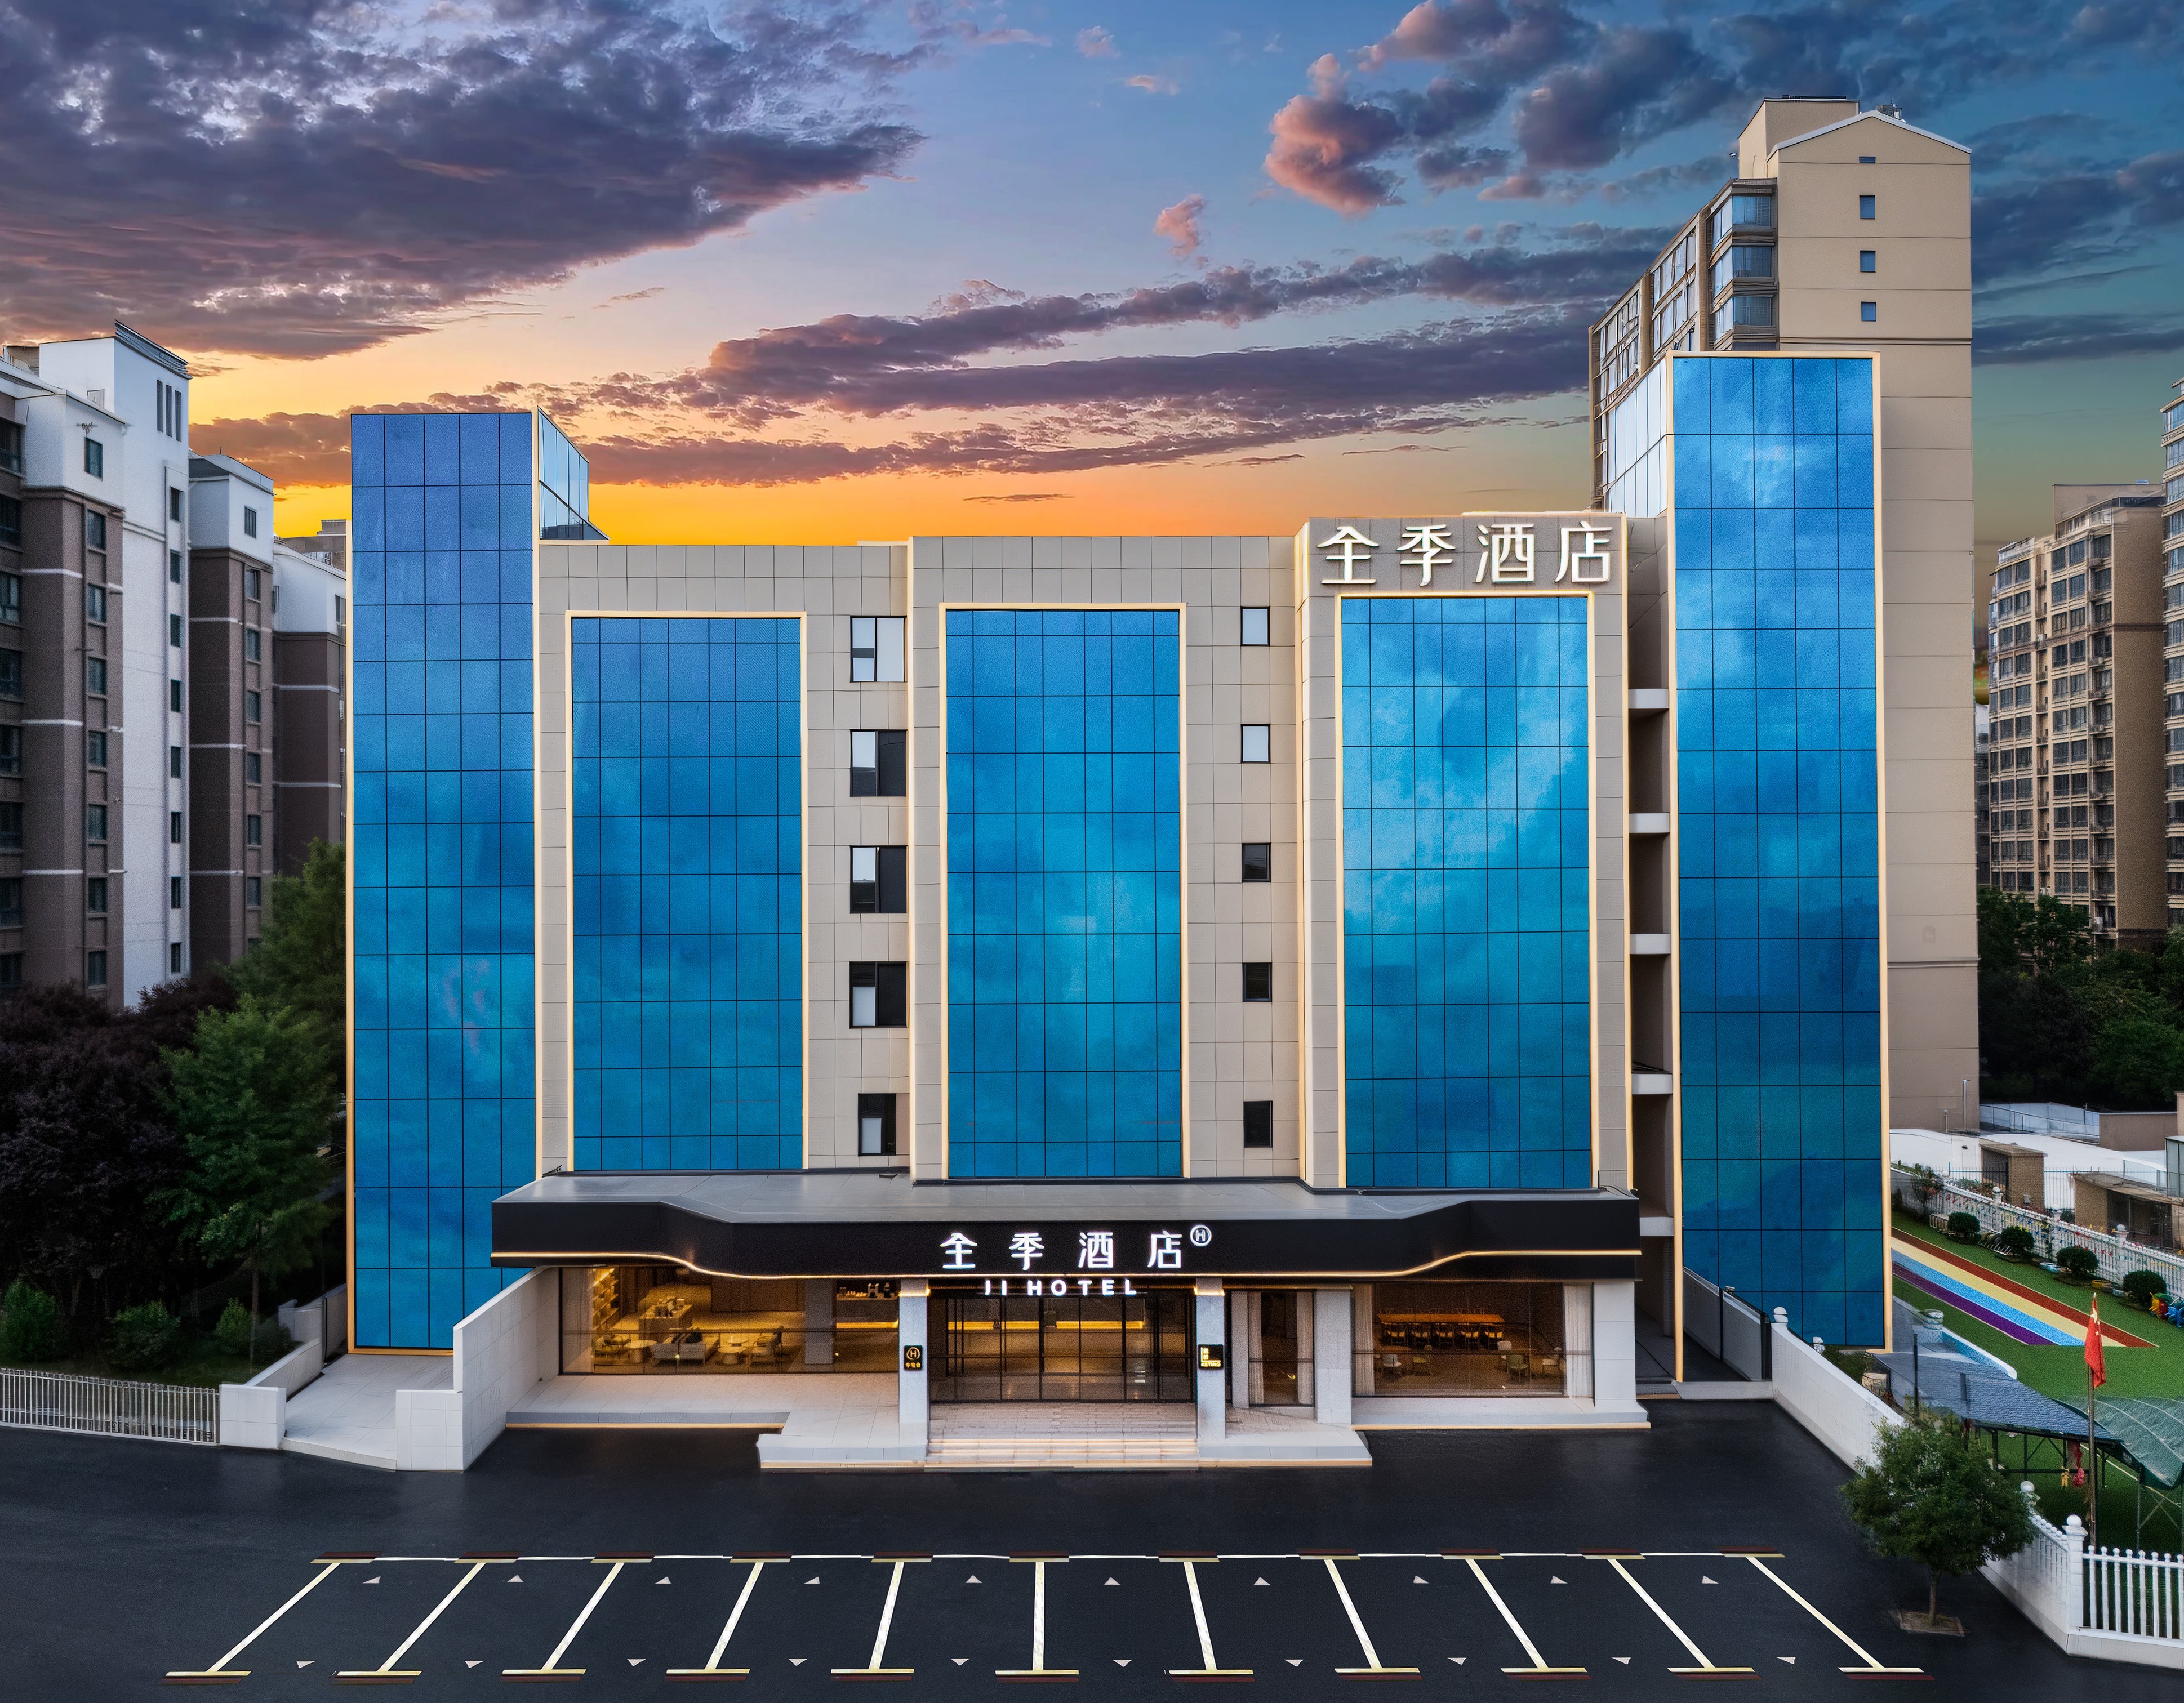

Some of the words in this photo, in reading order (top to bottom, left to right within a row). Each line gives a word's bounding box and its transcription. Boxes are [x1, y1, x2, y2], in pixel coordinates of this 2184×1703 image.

[1317, 520, 1613, 586] 全季酒店
[940, 1230, 1182, 1270] 全季酒店
[984, 1279, 1007, 1296] JI
[1027, 1279, 1137, 1296] HOTEL
